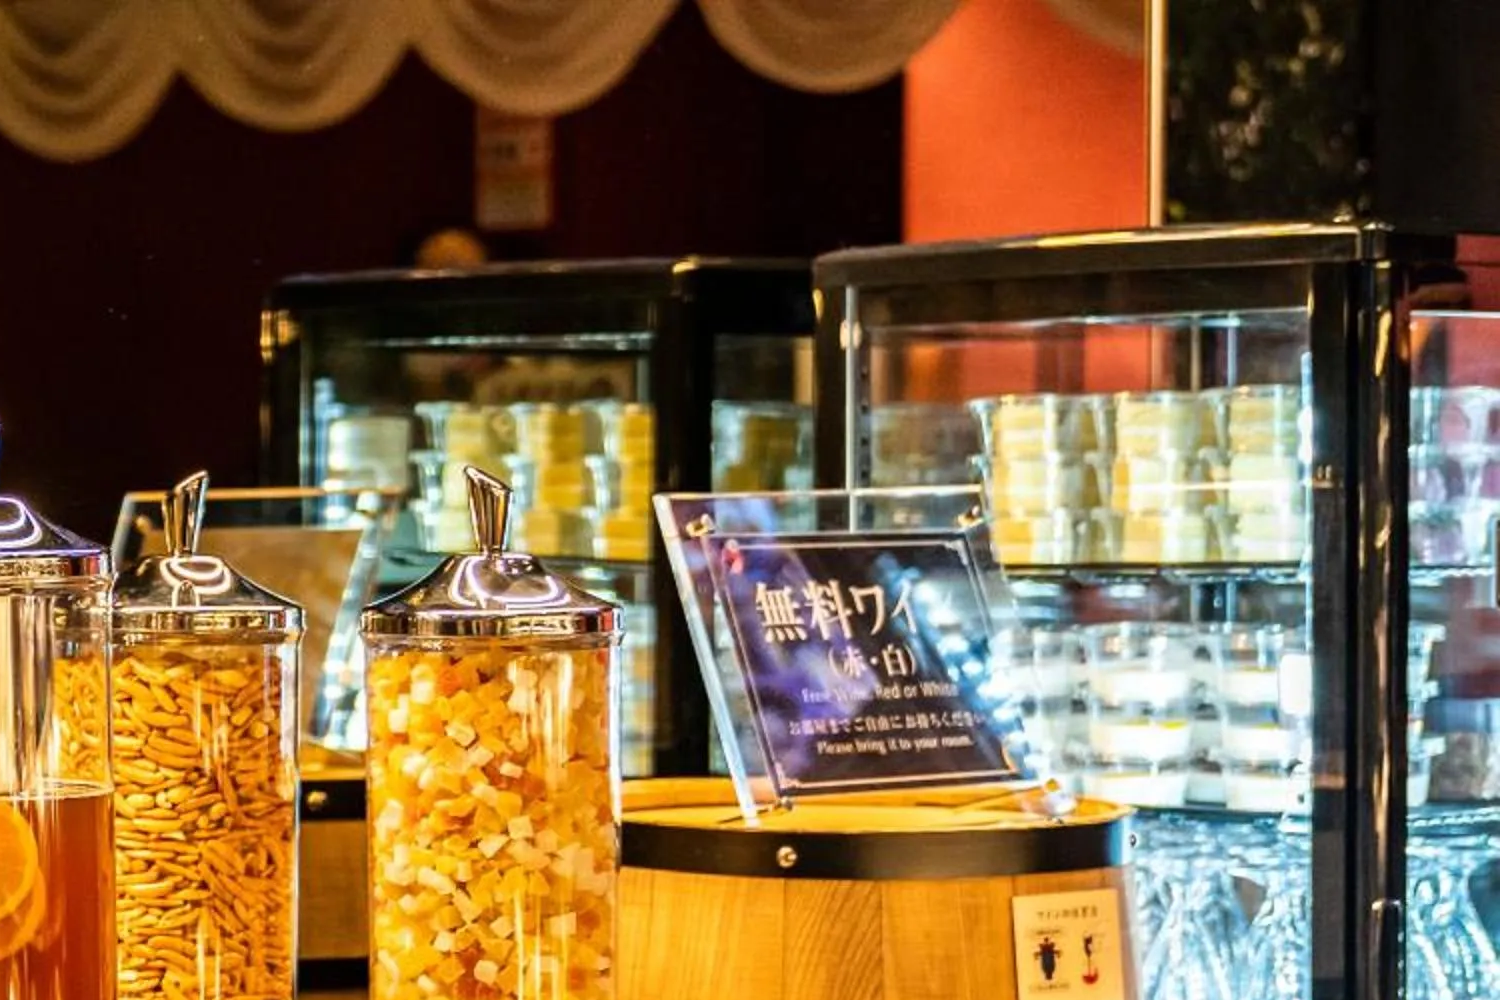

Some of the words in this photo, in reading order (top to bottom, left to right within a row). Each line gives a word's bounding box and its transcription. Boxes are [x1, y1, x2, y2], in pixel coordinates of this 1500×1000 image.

[755, 577, 955, 645] 無料ワイ
[875, 683, 902, 700] Red
[903, 684, 918, 699] or
[816, 740, 854, 755] Please
[854, 738, 888, 756] bring
[898, 738, 912, 751] to
[913, 737, 938, 754] your
